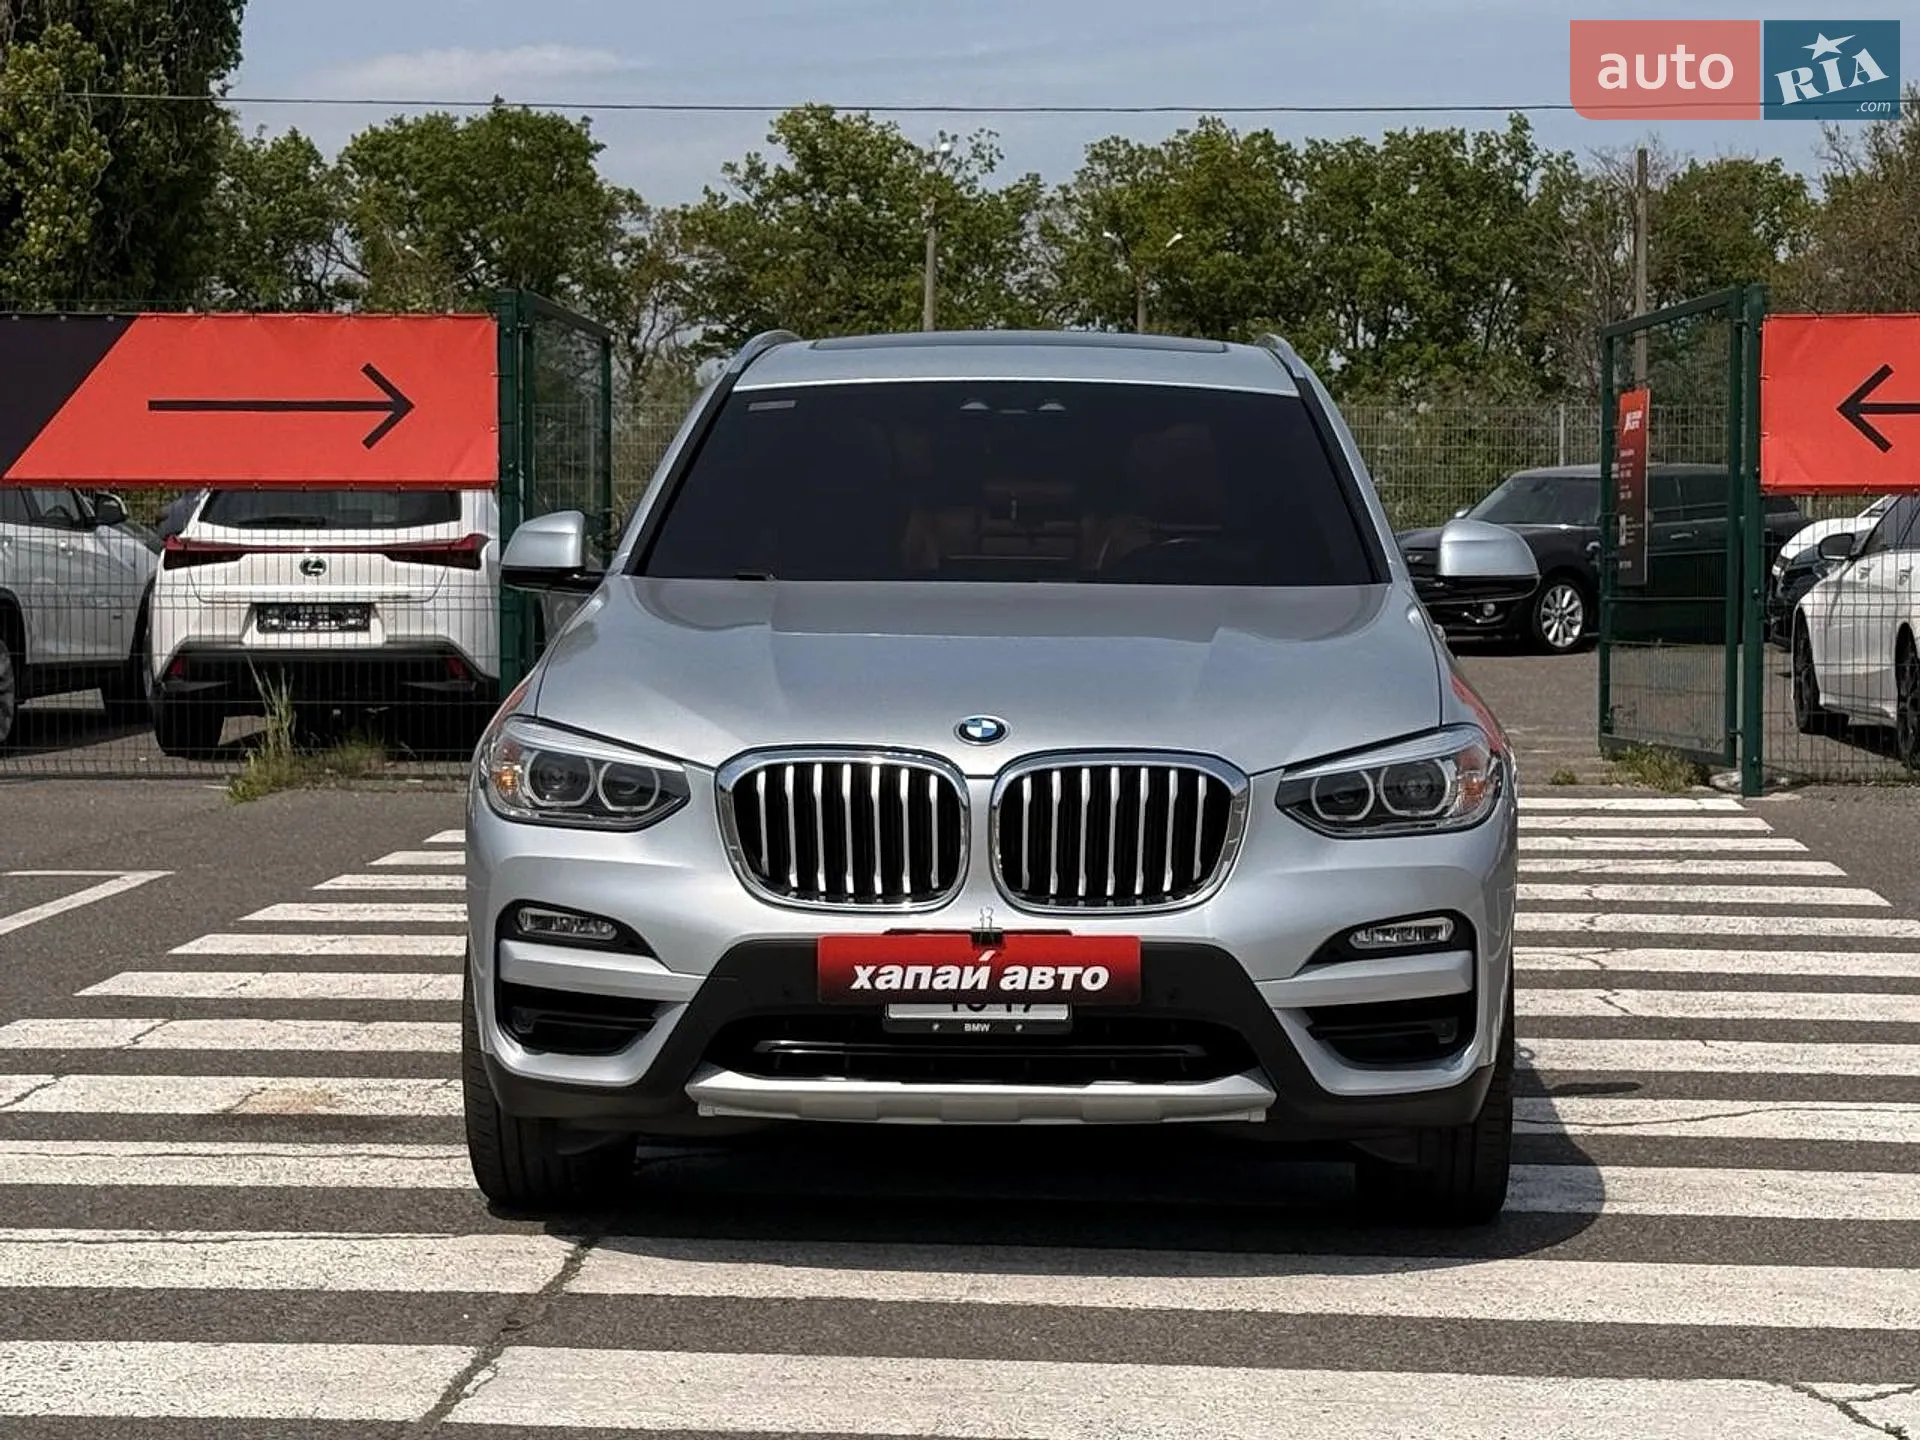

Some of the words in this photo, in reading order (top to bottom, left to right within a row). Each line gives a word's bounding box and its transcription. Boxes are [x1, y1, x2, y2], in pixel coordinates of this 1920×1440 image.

[850, 949, 997, 991] хапай
[999, 964, 1110, 991] авто
[963, 1022, 991, 1032] BMW
